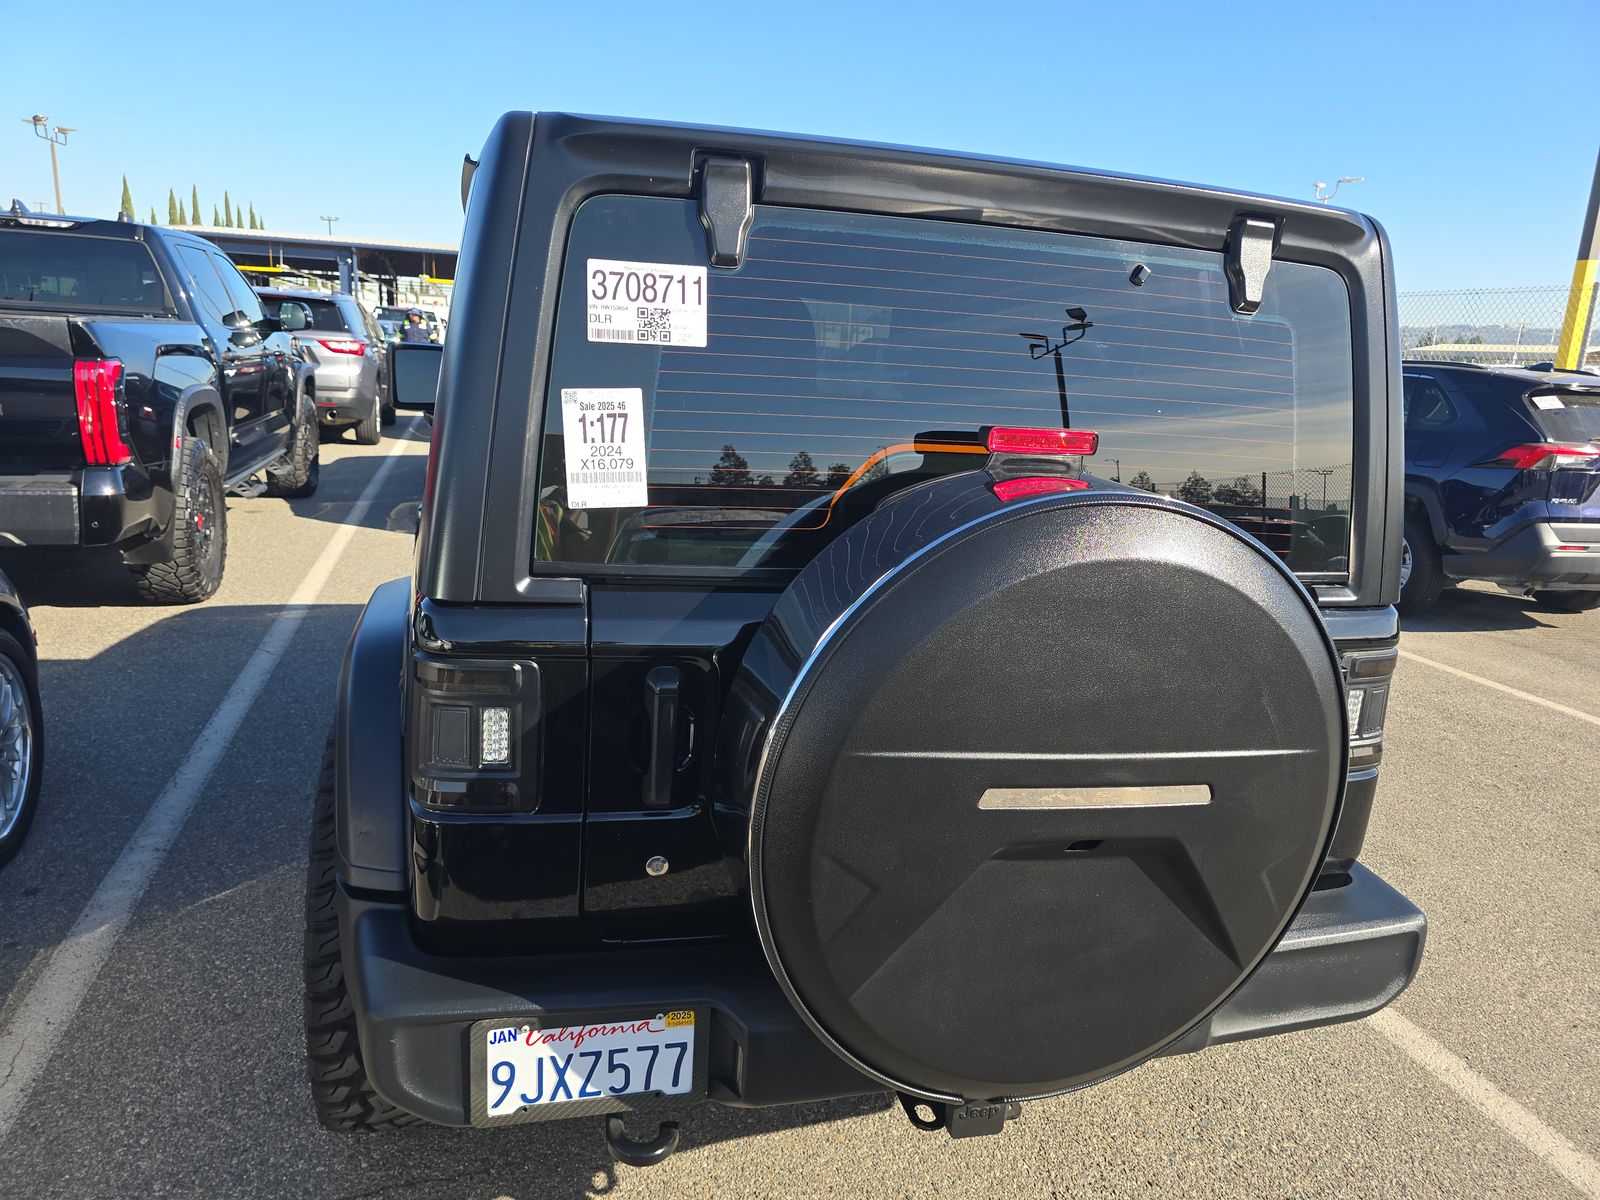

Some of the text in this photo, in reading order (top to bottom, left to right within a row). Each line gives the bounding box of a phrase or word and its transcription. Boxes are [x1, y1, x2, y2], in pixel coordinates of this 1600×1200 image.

[591, 269, 702, 305] 3708711
[589, 313, 612, 324] DLR
[579, 401, 626, 411] Sale 2025 46
[578, 413, 628, 444] 1:177
[590, 446, 623, 457] 2024
[581, 458, 634, 471] X16,079
[670, 1011, 692, 1020] 2025
[489, 1020, 665, 1049] JAN California
[491, 1042, 688, 1109] 9JXZ577
[958, 1105, 1000, 1120] Jeep
